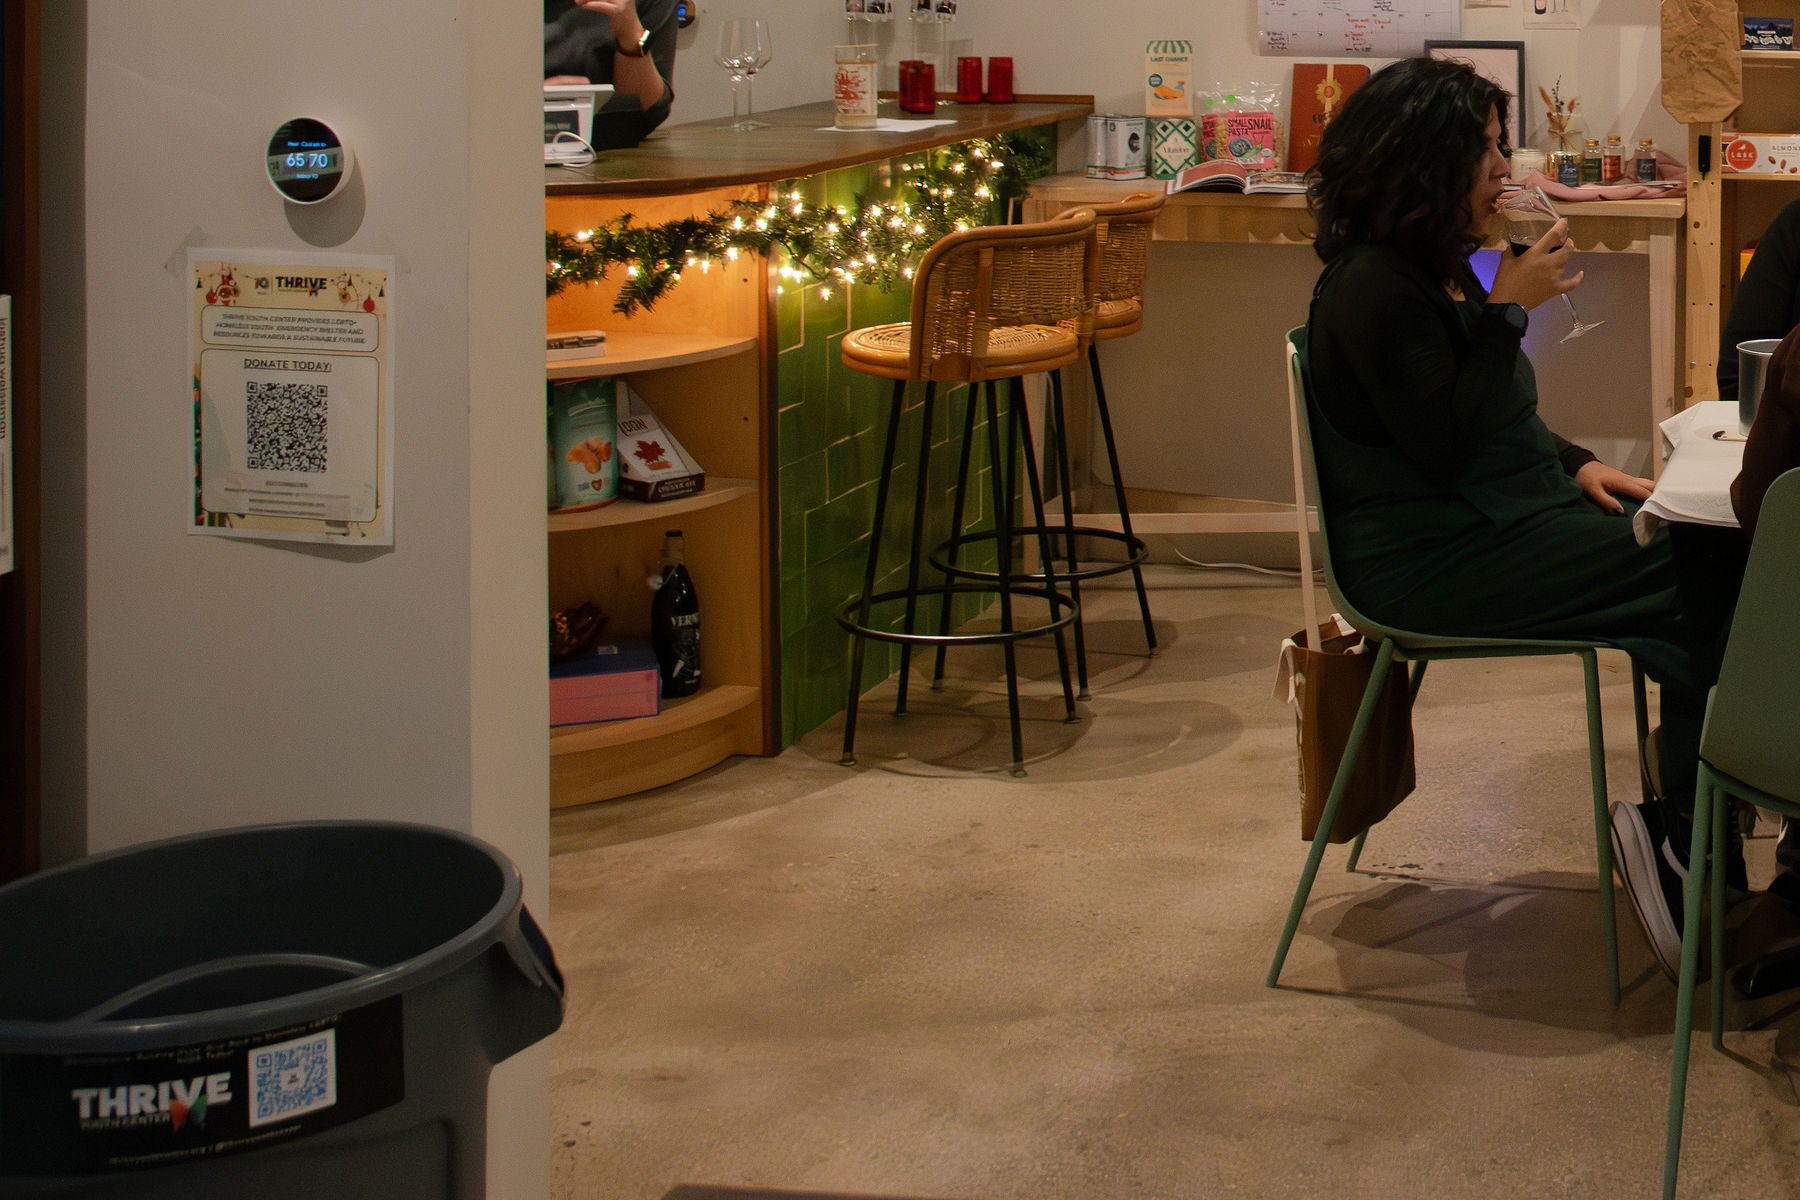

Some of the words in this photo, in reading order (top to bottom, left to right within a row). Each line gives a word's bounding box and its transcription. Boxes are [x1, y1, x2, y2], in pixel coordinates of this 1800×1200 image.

[1248, 118, 1273, 130] SNAIL
[286, 152, 305, 168] 65
[309, 153, 328, 169] 70
[275, 276, 328, 291] THRIVE
[244, 358, 290, 370] DONATE
[72, 1071, 233, 1119] THRIVE
